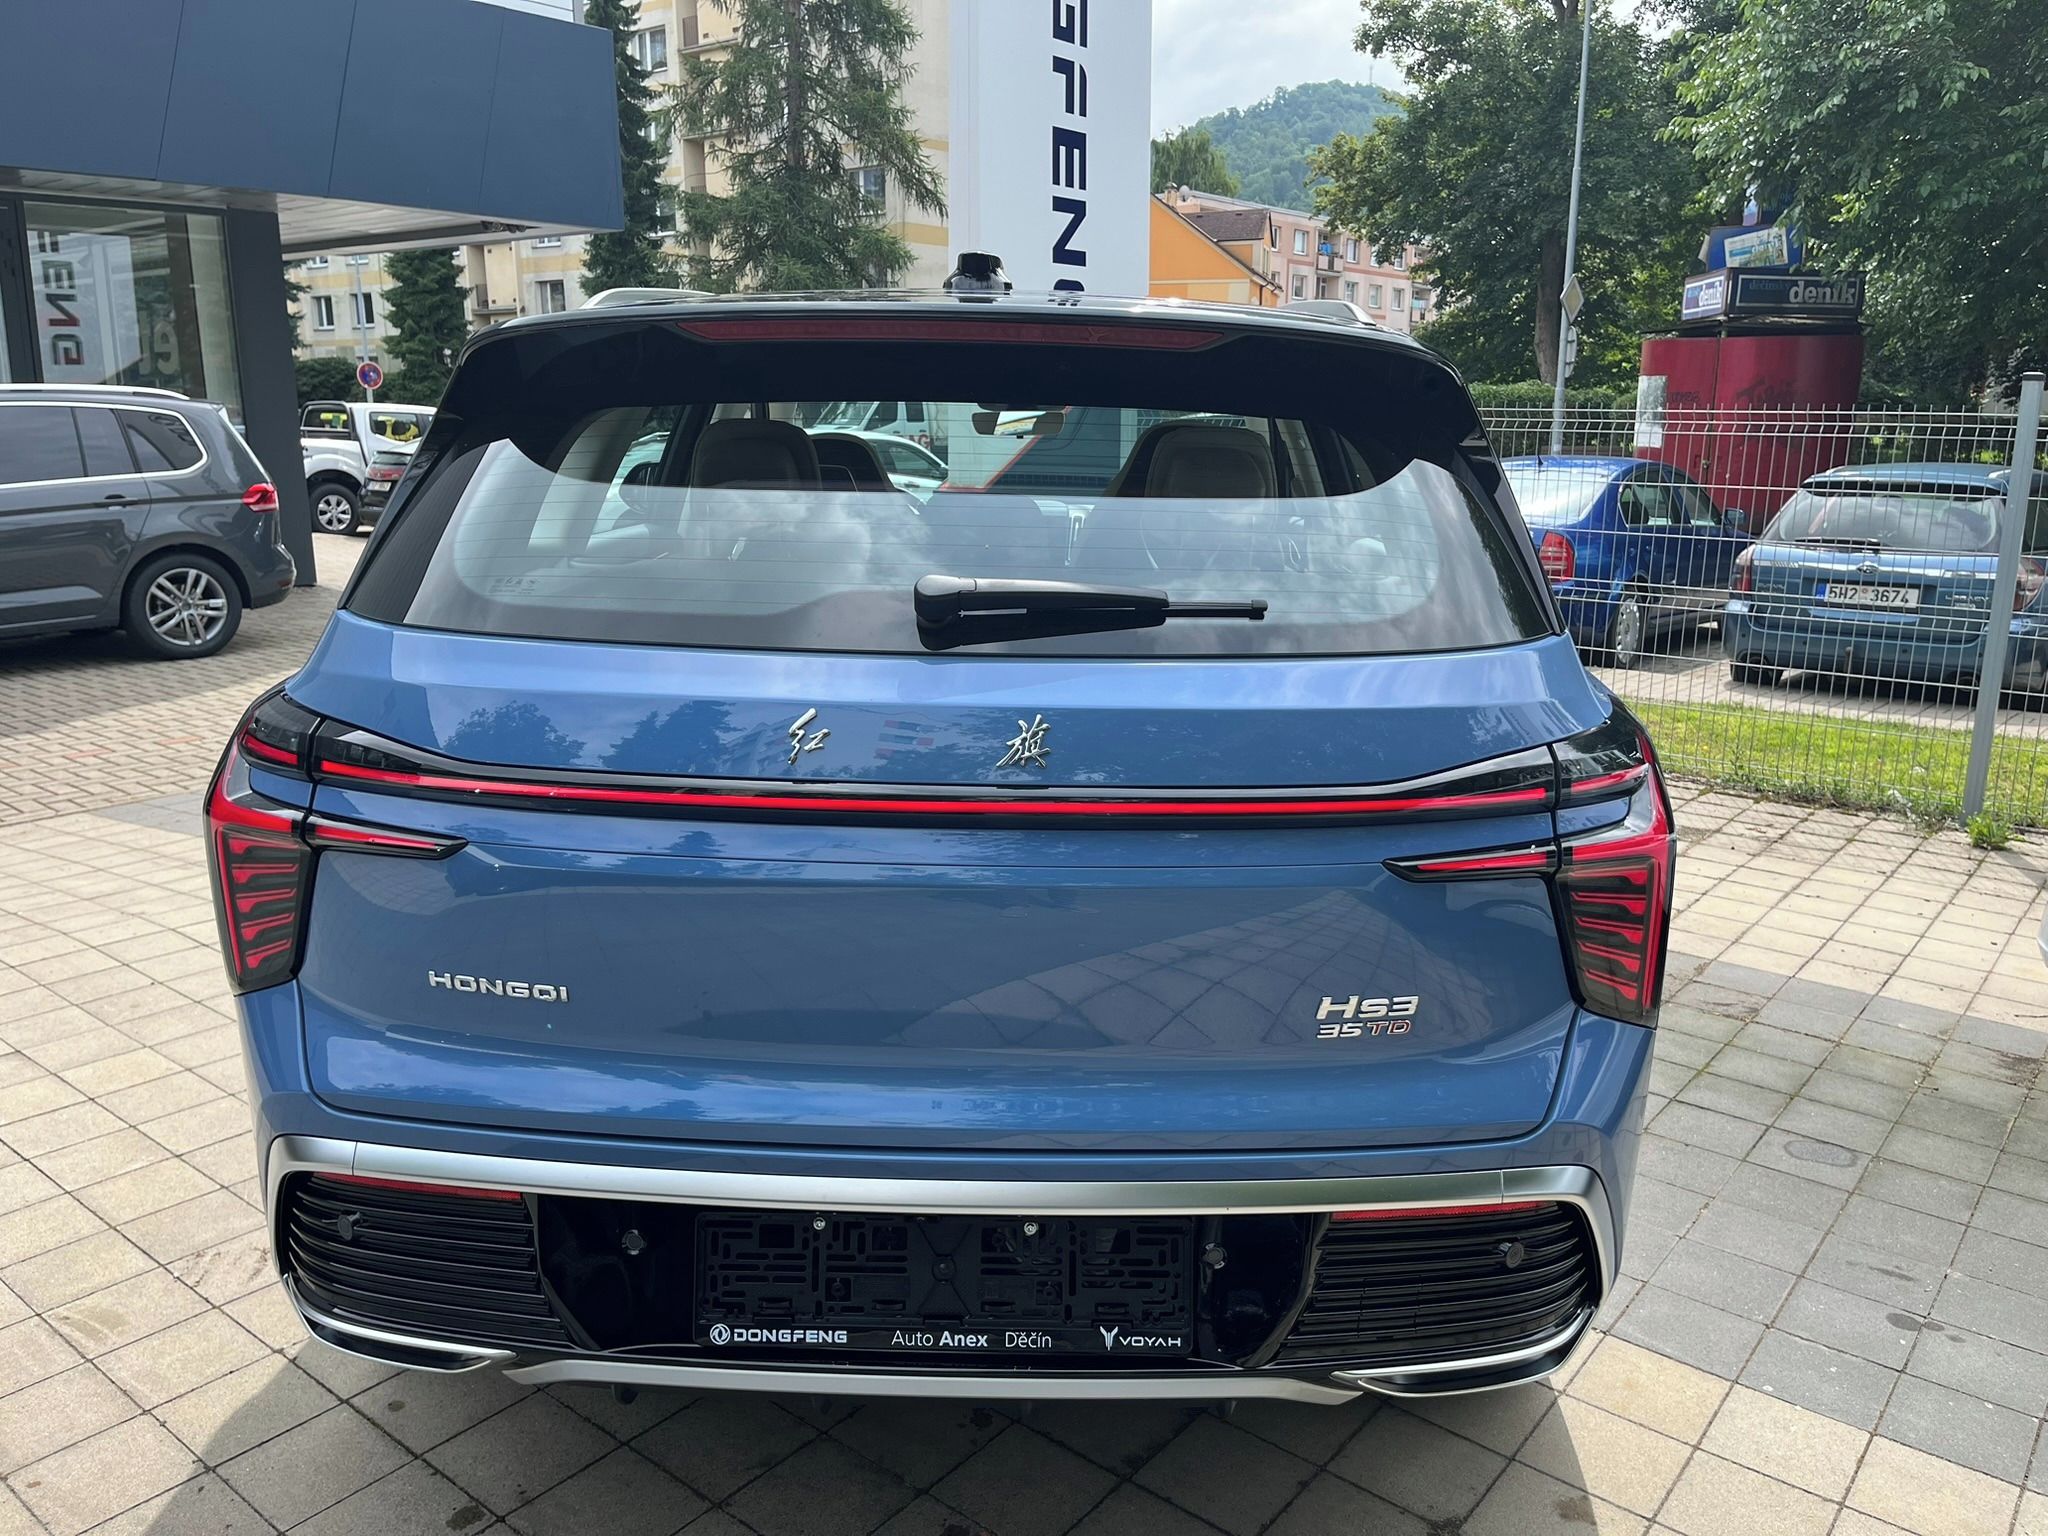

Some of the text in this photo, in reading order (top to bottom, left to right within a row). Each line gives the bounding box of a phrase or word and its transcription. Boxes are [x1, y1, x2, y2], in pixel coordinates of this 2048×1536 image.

[1052, 0, 1087, 292] GFEN
[1829, 585, 1909, 604] 5H2 3674
[428, 970, 569, 1002] HONGQI
[1316, 995, 1419, 1020] HS3
[733, 1328, 848, 1344] DONGFENG
[891, 1330, 1052, 1349] Auto Anex Děčín
[1118, 1335, 1182, 1348] VOYAH
